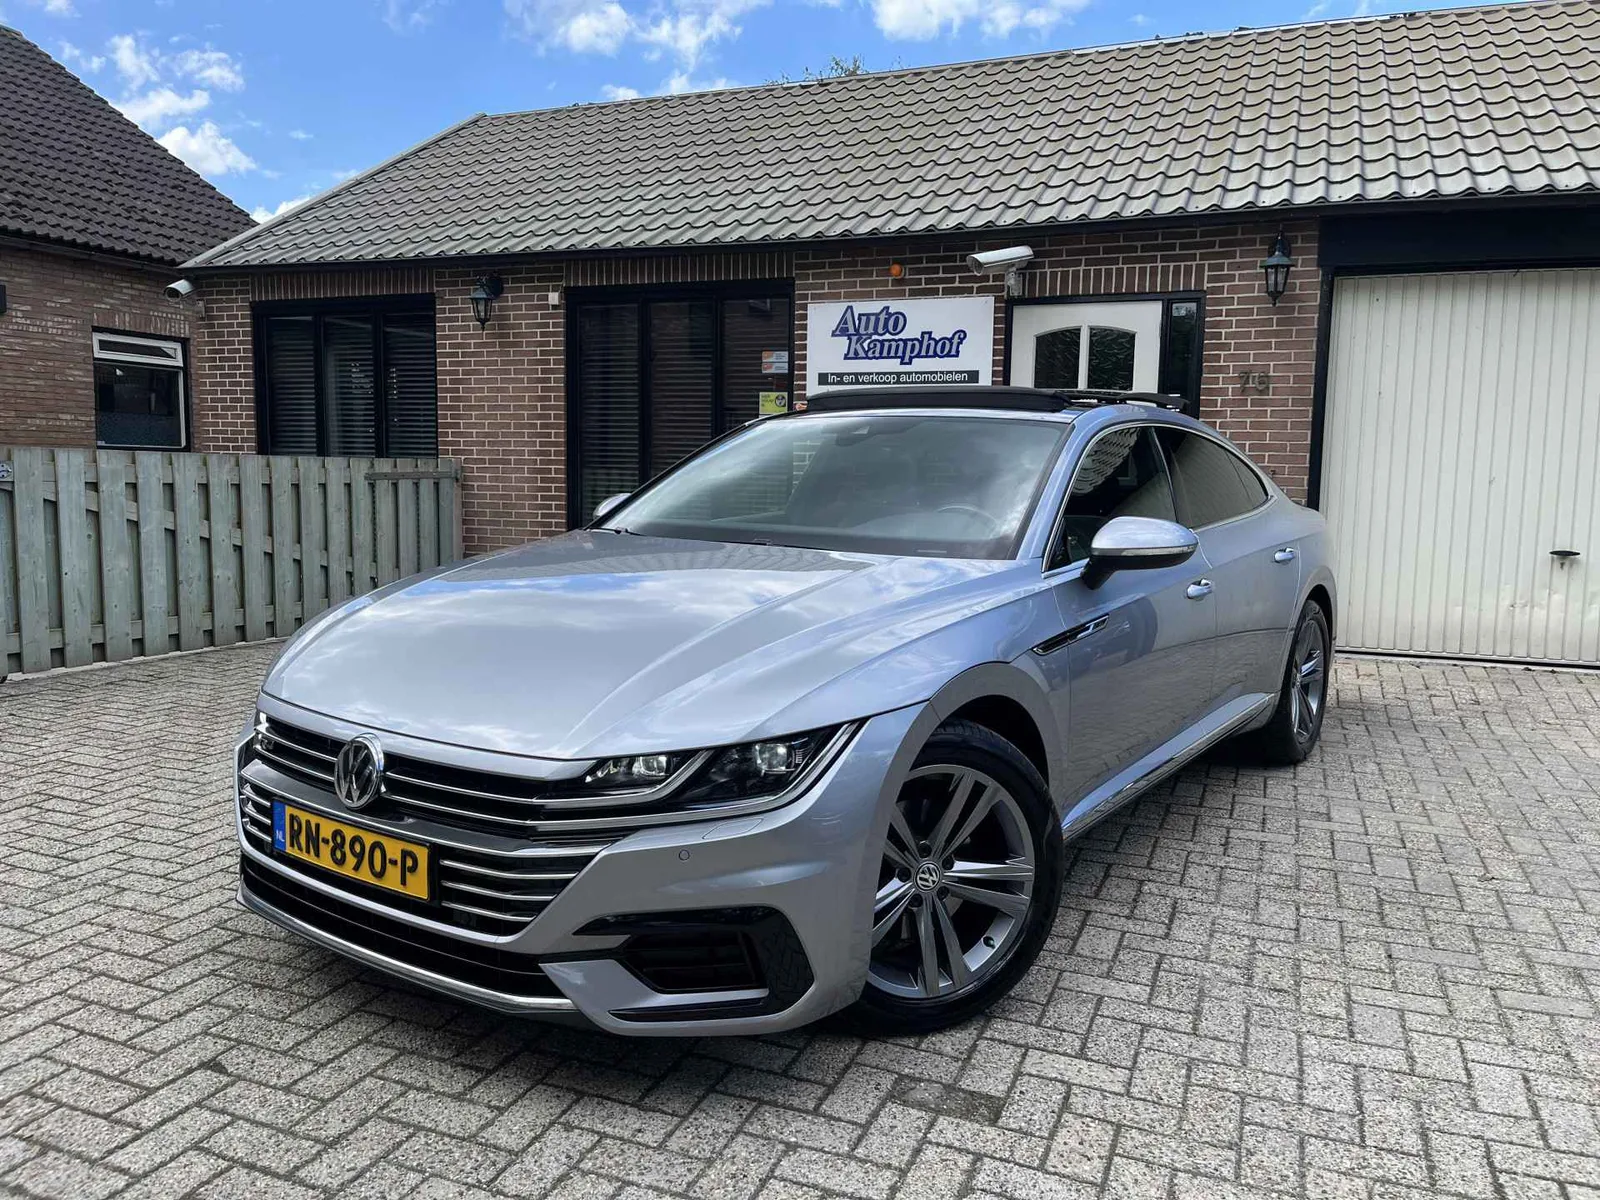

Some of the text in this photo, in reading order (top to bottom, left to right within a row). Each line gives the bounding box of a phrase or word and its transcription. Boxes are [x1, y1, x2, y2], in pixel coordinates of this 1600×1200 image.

[831, 305, 907, 337] Auto
[844, 329, 967, 365] Kamphof
[828, 371, 968, 385] In- en verkoop automobielen
[275, 829, 285, 842] NL
[289, 813, 419, 887] RN-890-P
